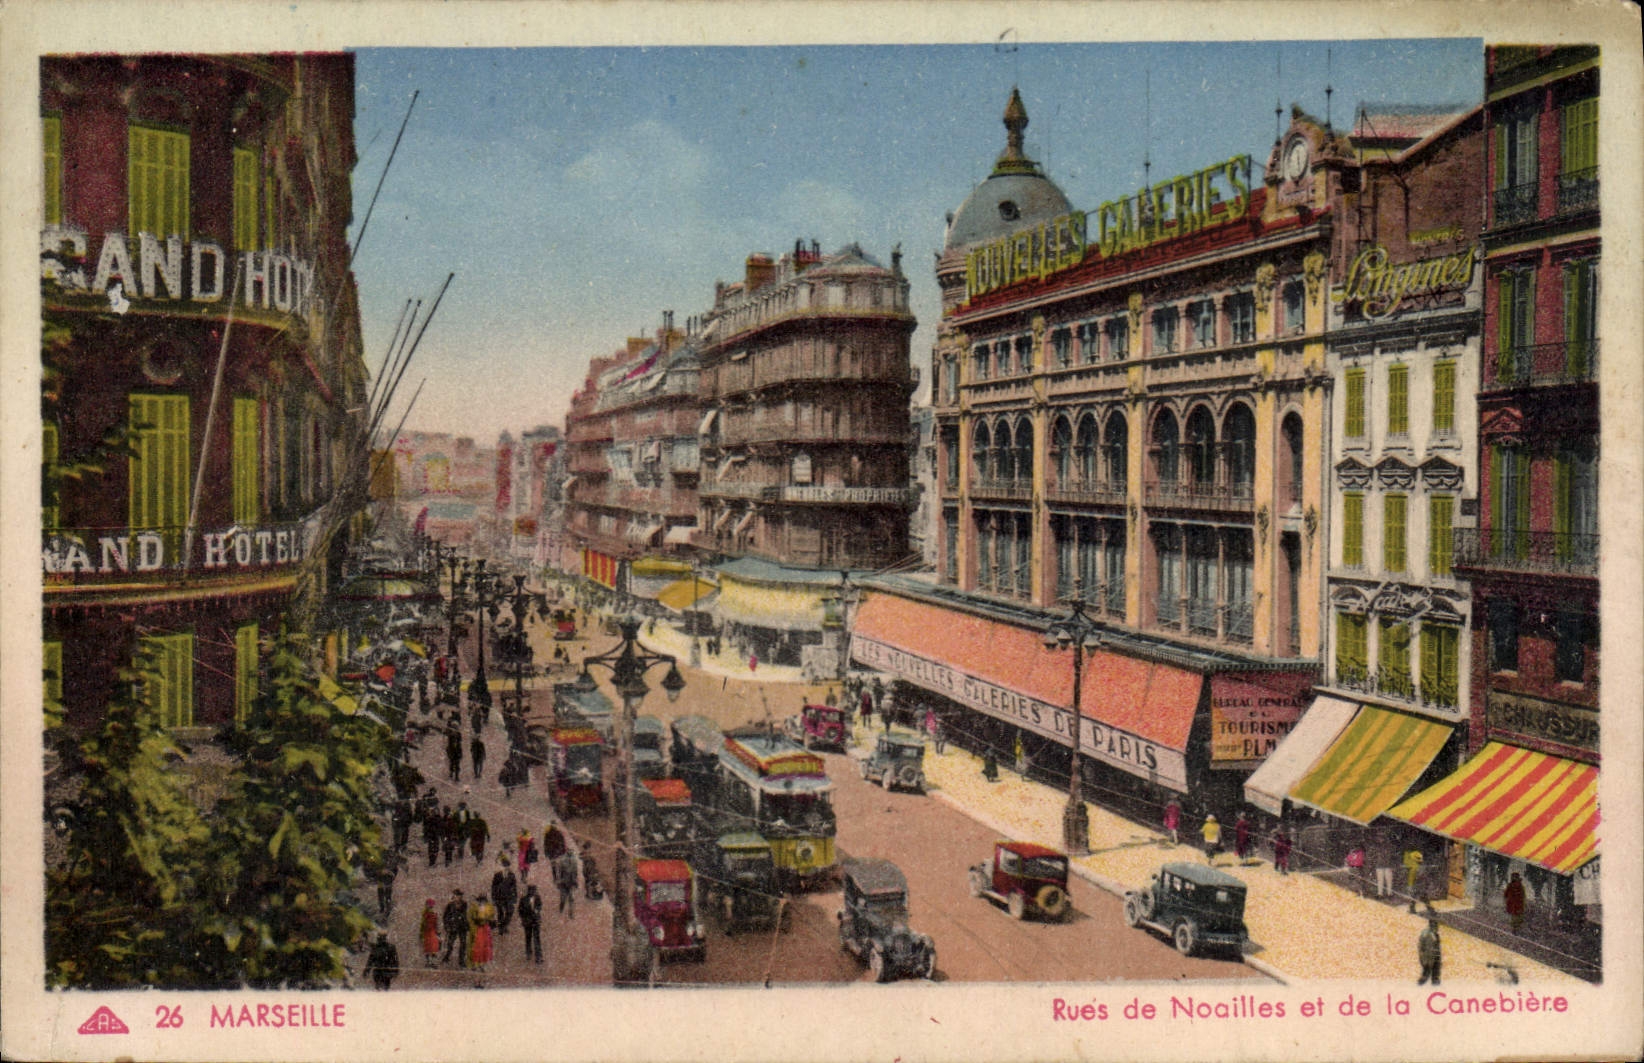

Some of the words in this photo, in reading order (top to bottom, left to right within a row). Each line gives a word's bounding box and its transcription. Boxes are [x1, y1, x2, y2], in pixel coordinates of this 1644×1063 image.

[1098, 153, 1249, 258] GALERIES
[203, 530, 300, 568] HOTEL
[1092, 724, 1158, 770] PARIS
